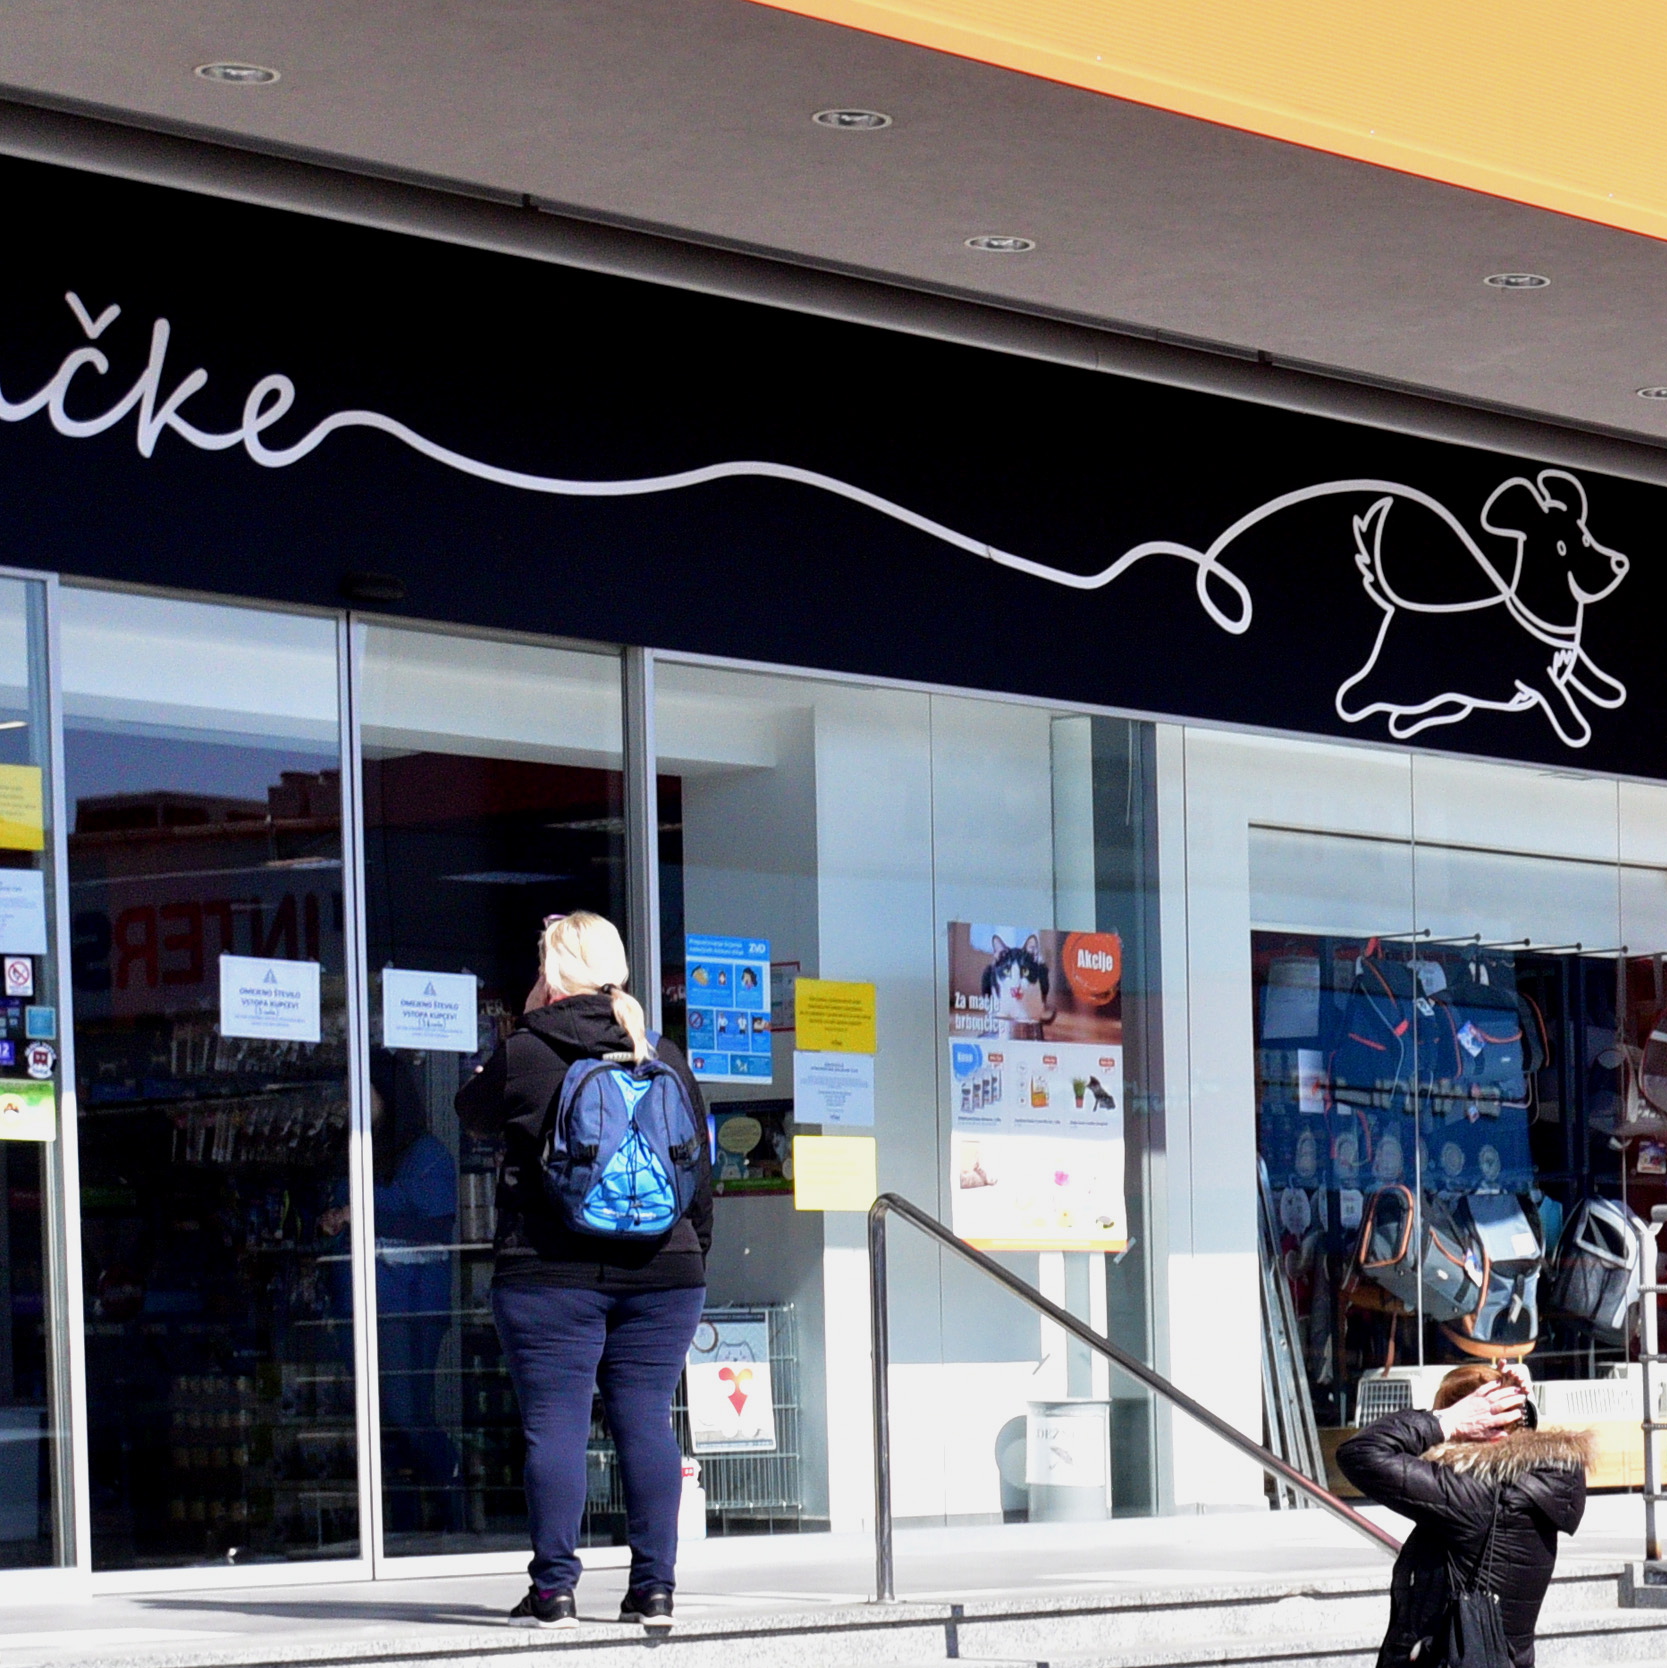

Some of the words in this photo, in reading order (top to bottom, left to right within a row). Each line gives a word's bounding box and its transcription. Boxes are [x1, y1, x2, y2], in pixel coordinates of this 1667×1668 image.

[0, 290, 298, 468] čke
[1077, 949, 1113, 973] Akcije
[954, 992, 967, 1009] Za
